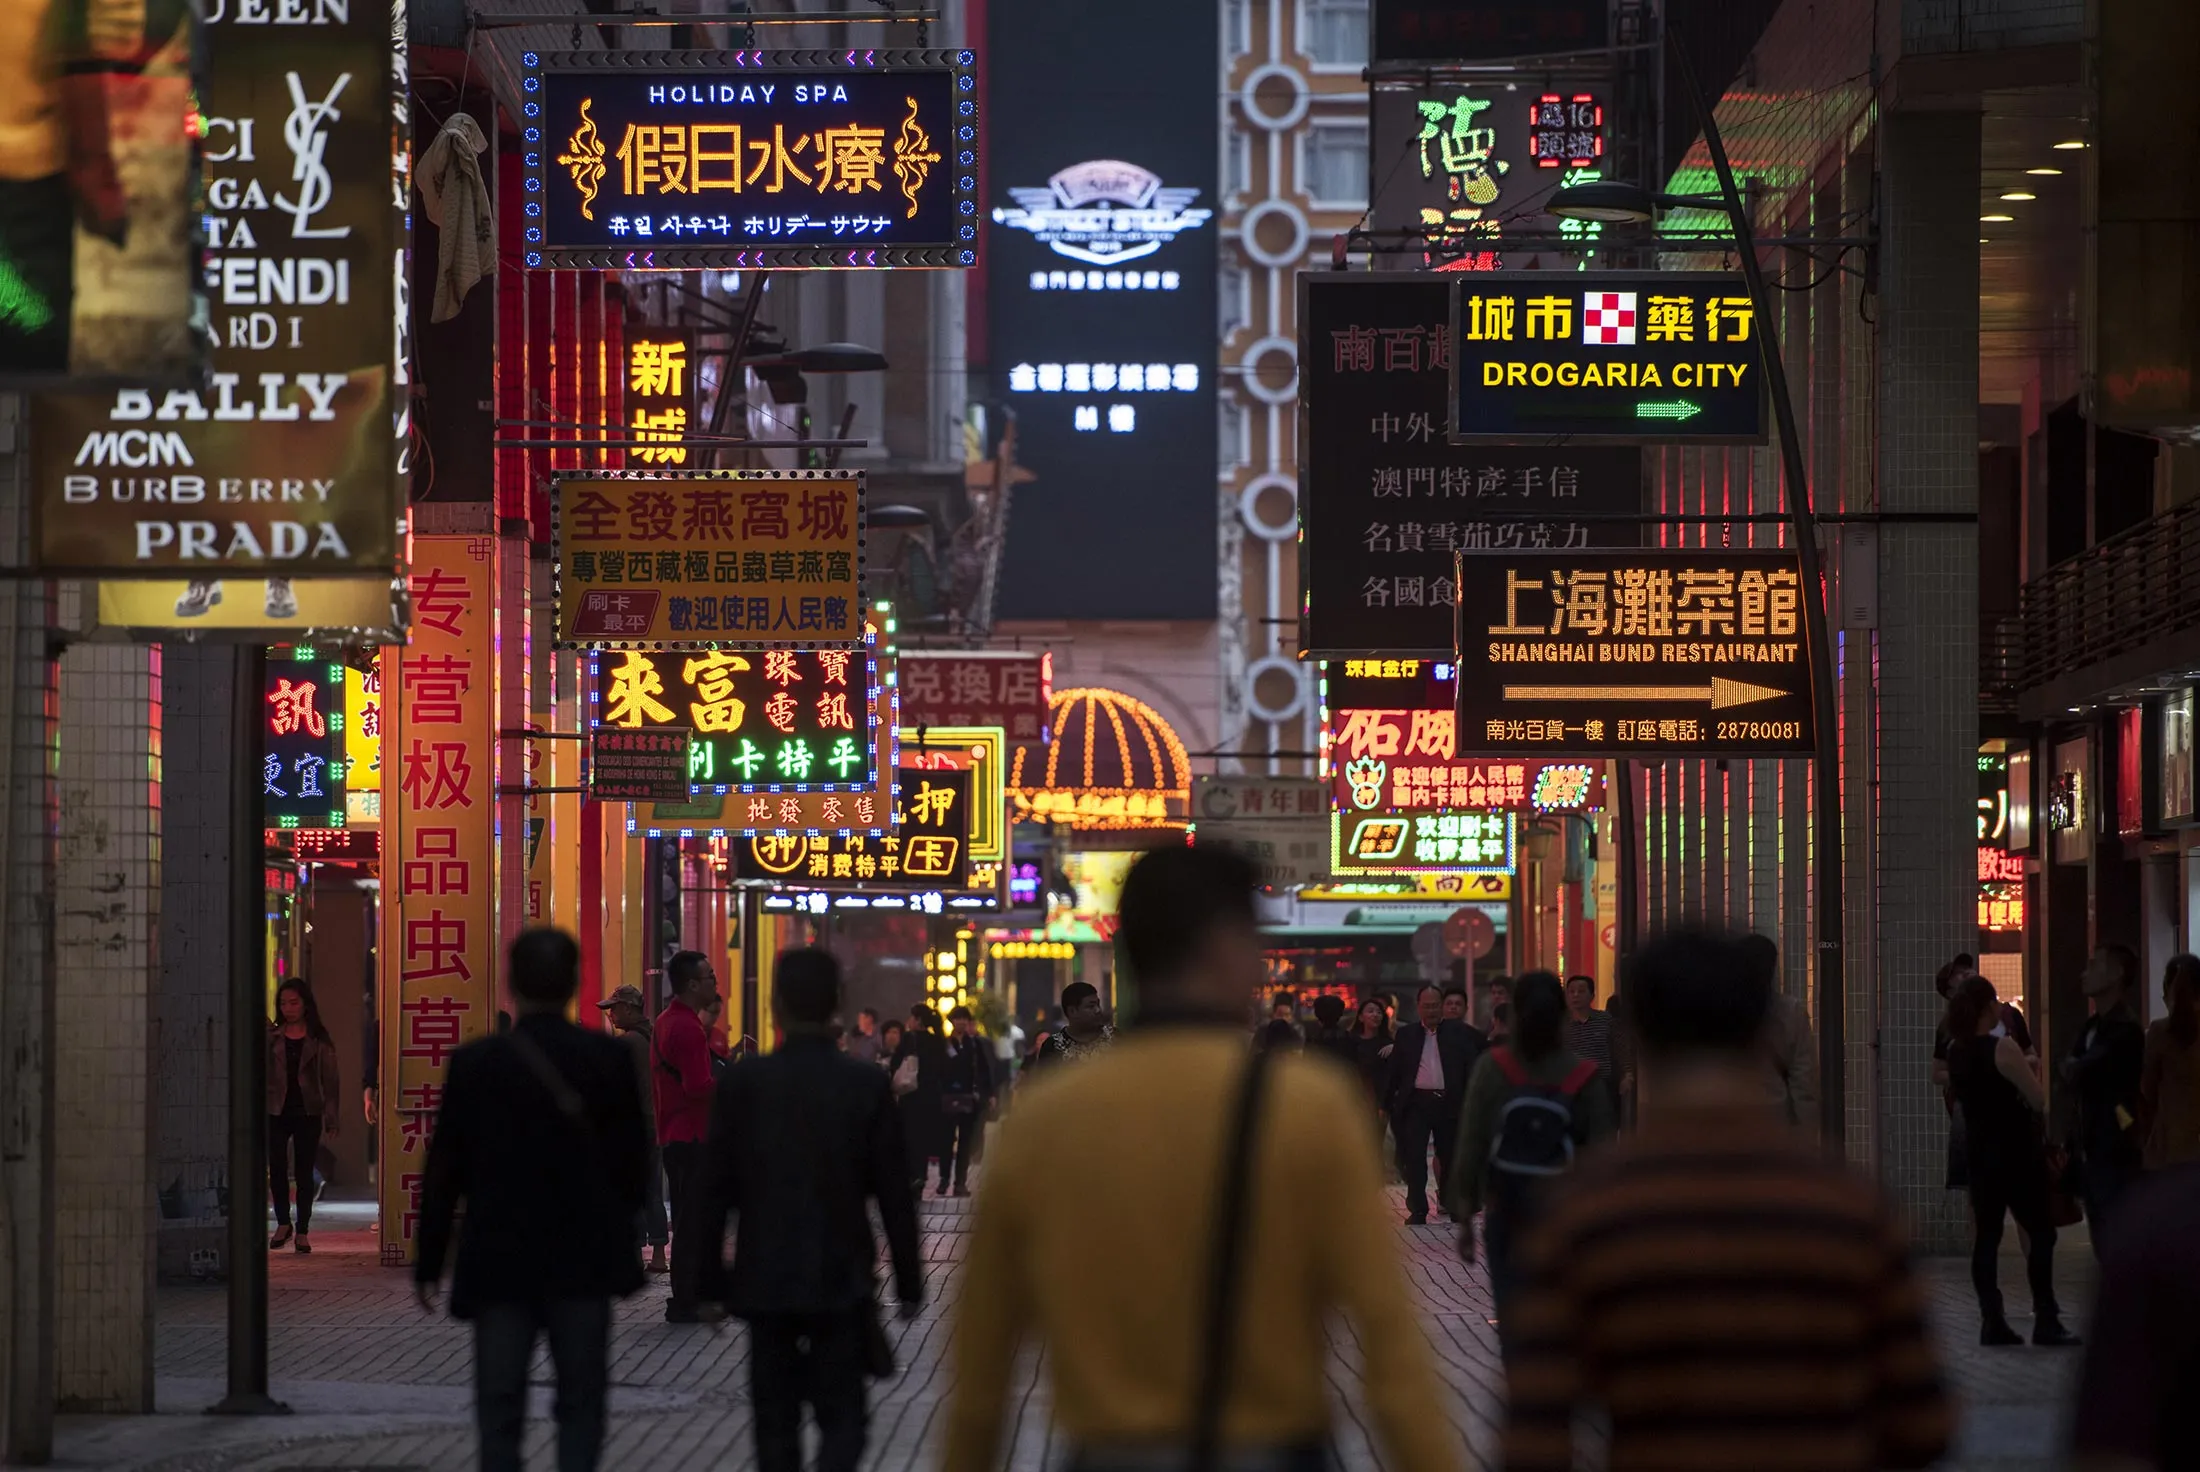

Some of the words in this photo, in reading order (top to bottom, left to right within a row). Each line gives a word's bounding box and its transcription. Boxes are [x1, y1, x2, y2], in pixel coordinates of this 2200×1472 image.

[649, 85, 776, 104] HOLIDAY
[795, 85, 849, 103] SPA
[615, 122, 886, 196] 假日水療
[659, 215, 732, 236] 사우나
[743, 216, 892, 236] ホリデーサウナ
[1467, 295, 1572, 341] 城市
[1646, 295, 1753, 342] 藥行
[1482, 362, 1663, 388] DROGARIA
[1671, 363, 1748, 388] CITY
[630, 339, 687, 464] 新城
[74, 431, 194, 467] MCM
[1371, 465, 1580, 499] 澳門特產手信
[569, 489, 849, 541] 全發燕窩城
[135, 521, 349, 559] PRADA
[587, 594, 631, 611] 刷卡
[668, 595, 849, 632] 歡迎使用人民幣
[1487, 568, 1798, 636] 上海灘菜館
[603, 614, 646, 632] 最平
[1488, 642, 1593, 663] SHANGHAI
[1599, 642, 1655, 663] BUND
[1662, 642, 1798, 663] RESTAURANT
[764, 692, 854, 733] 電訊
[1485, 719, 1604, 742] 南光百貨一樓
[1717, 721, 1801, 740] 28780081
[747, 796, 803, 826] 批發
[822, 796, 876, 825] 零售
